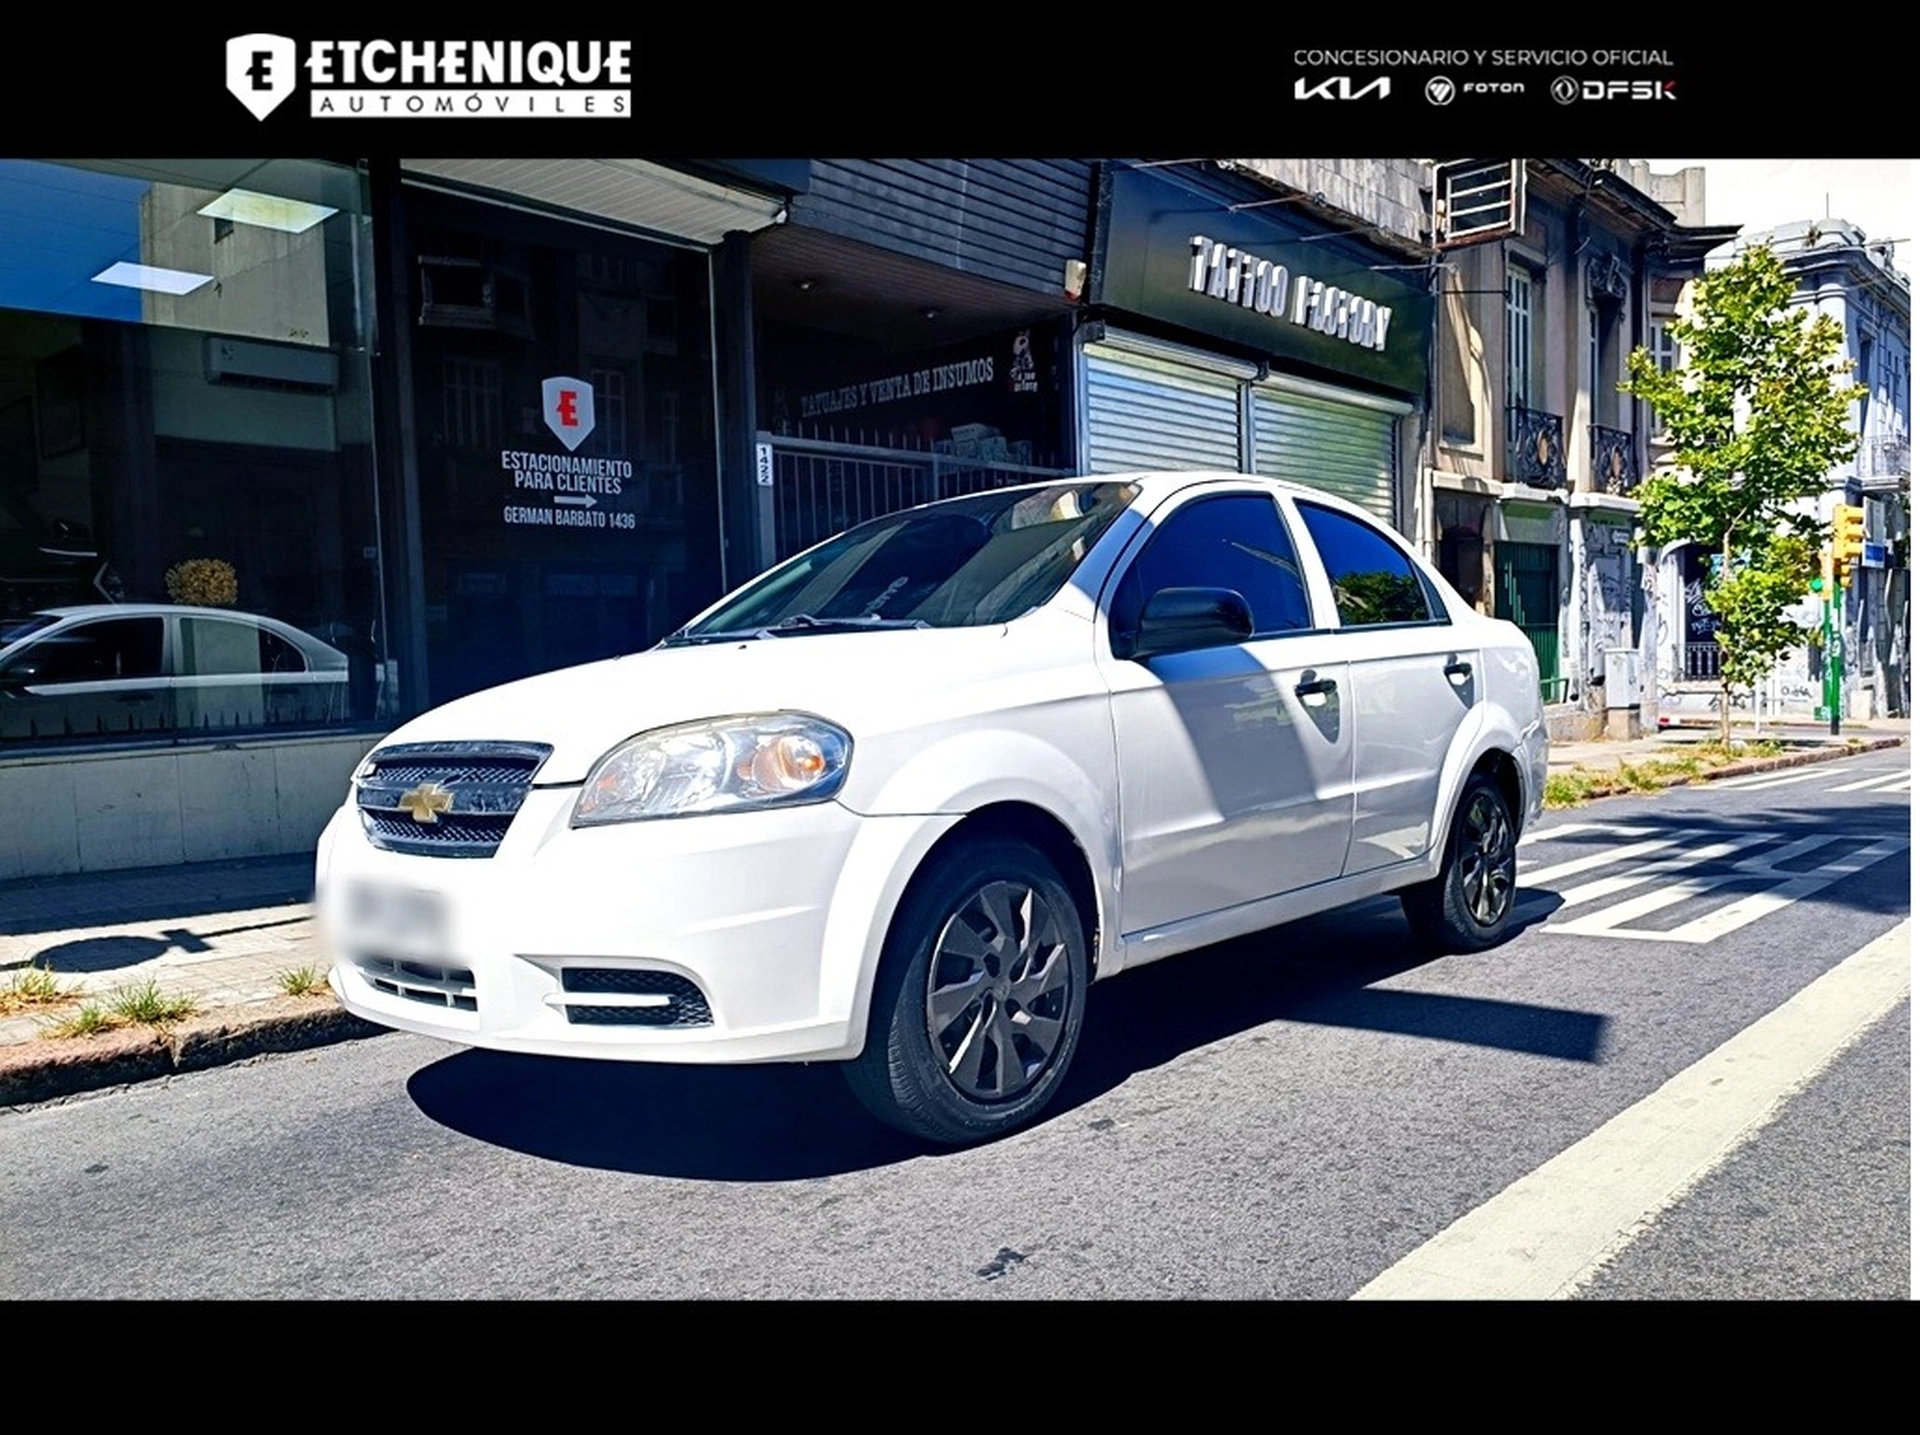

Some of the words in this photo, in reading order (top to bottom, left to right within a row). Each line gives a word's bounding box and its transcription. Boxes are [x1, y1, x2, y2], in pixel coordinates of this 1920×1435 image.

[1188, 235, 1289, 318] TATTOO
[1290, 275, 1393, 351] FACTORY
[802, 386, 858, 418] TATUAJES
[860, 383, 869, 406] Y
[870, 374, 911, 404] VENTA
[913, 369, 931, 395] DE
[932, 356, 994, 392] INSUMOS
[501, 450, 632, 479] ESTACIONAMIENTO
[758, 446, 770, 485] 1422
[514, 470, 554, 490] PARA
[557, 473, 622, 494] CLIENTES
[503, 506, 553, 525] GERMAN
[555, 509, 605, 528] BARBATO
[609, 513, 636, 529] 1436
